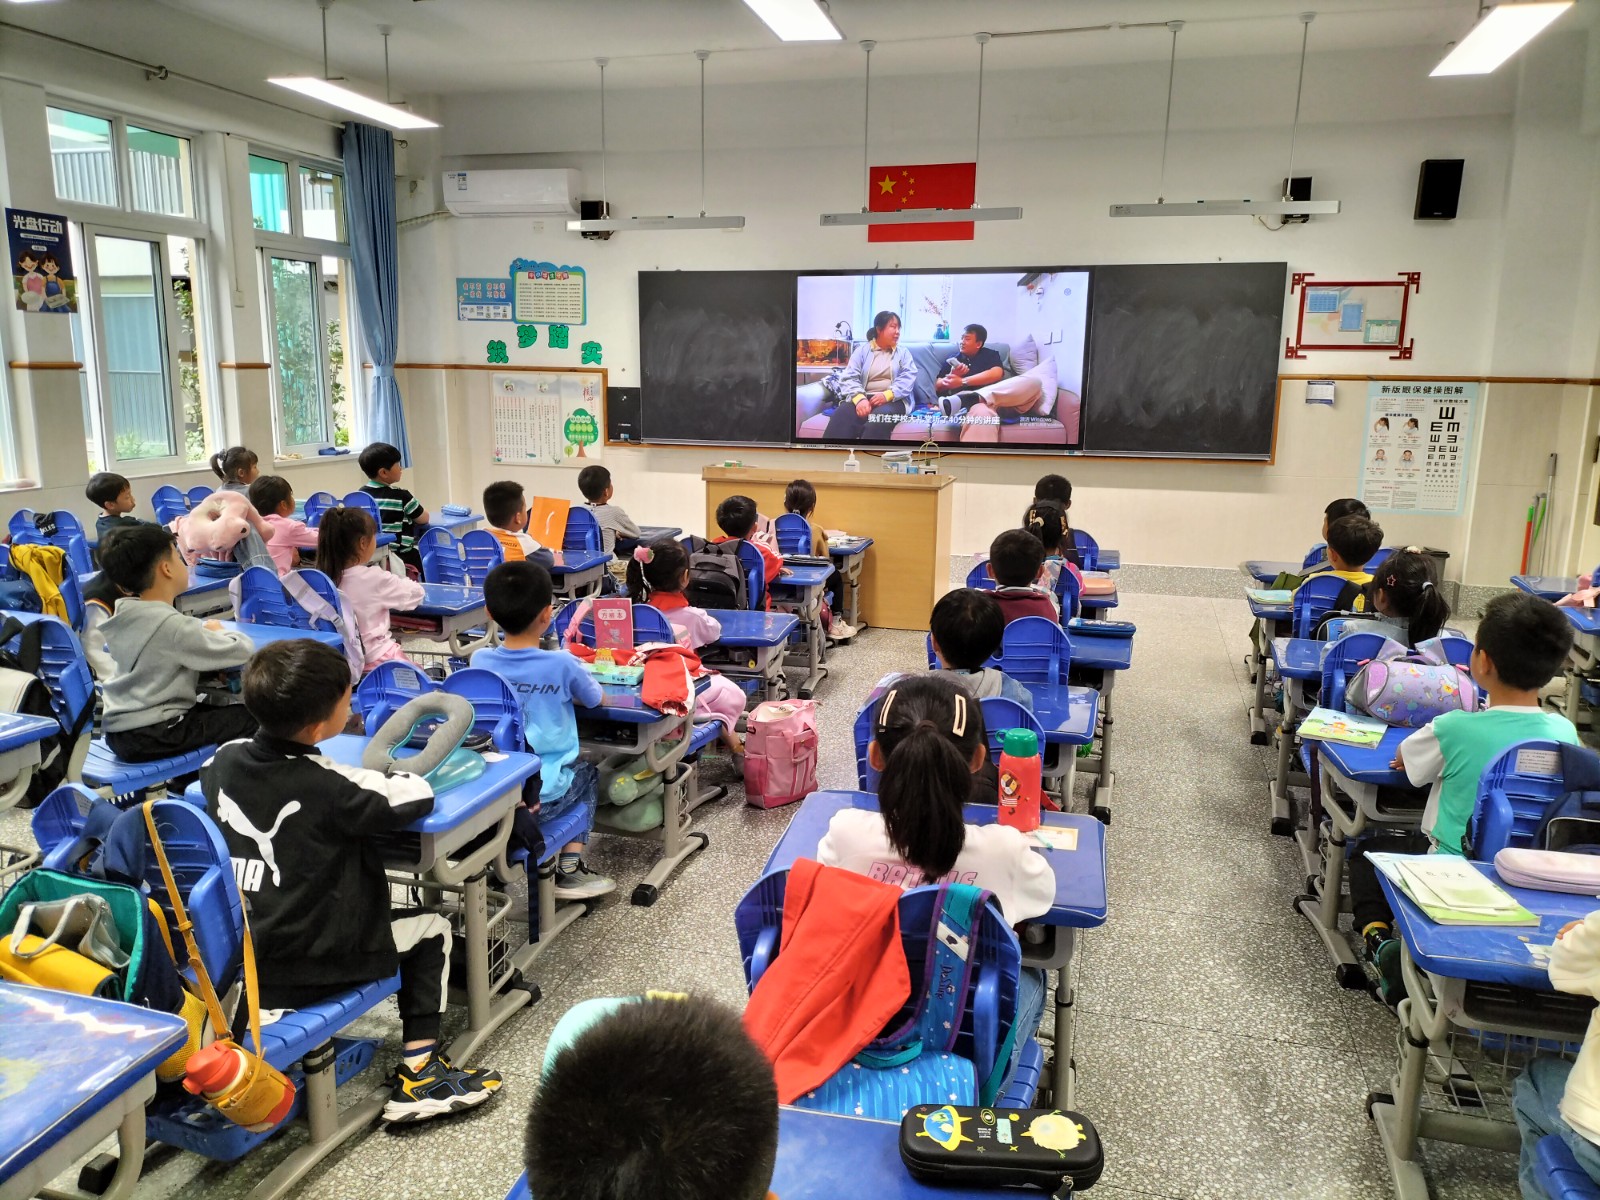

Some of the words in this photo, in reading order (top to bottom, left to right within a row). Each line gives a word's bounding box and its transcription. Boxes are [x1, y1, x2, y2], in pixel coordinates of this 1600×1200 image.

[13, 214, 63, 234] 光盘行动
[1381, 385, 1464, 395] 新版眼保健操图解
[868, 413, 1000, 425] 我们在学校大礼堂听了40分钟的讲座
